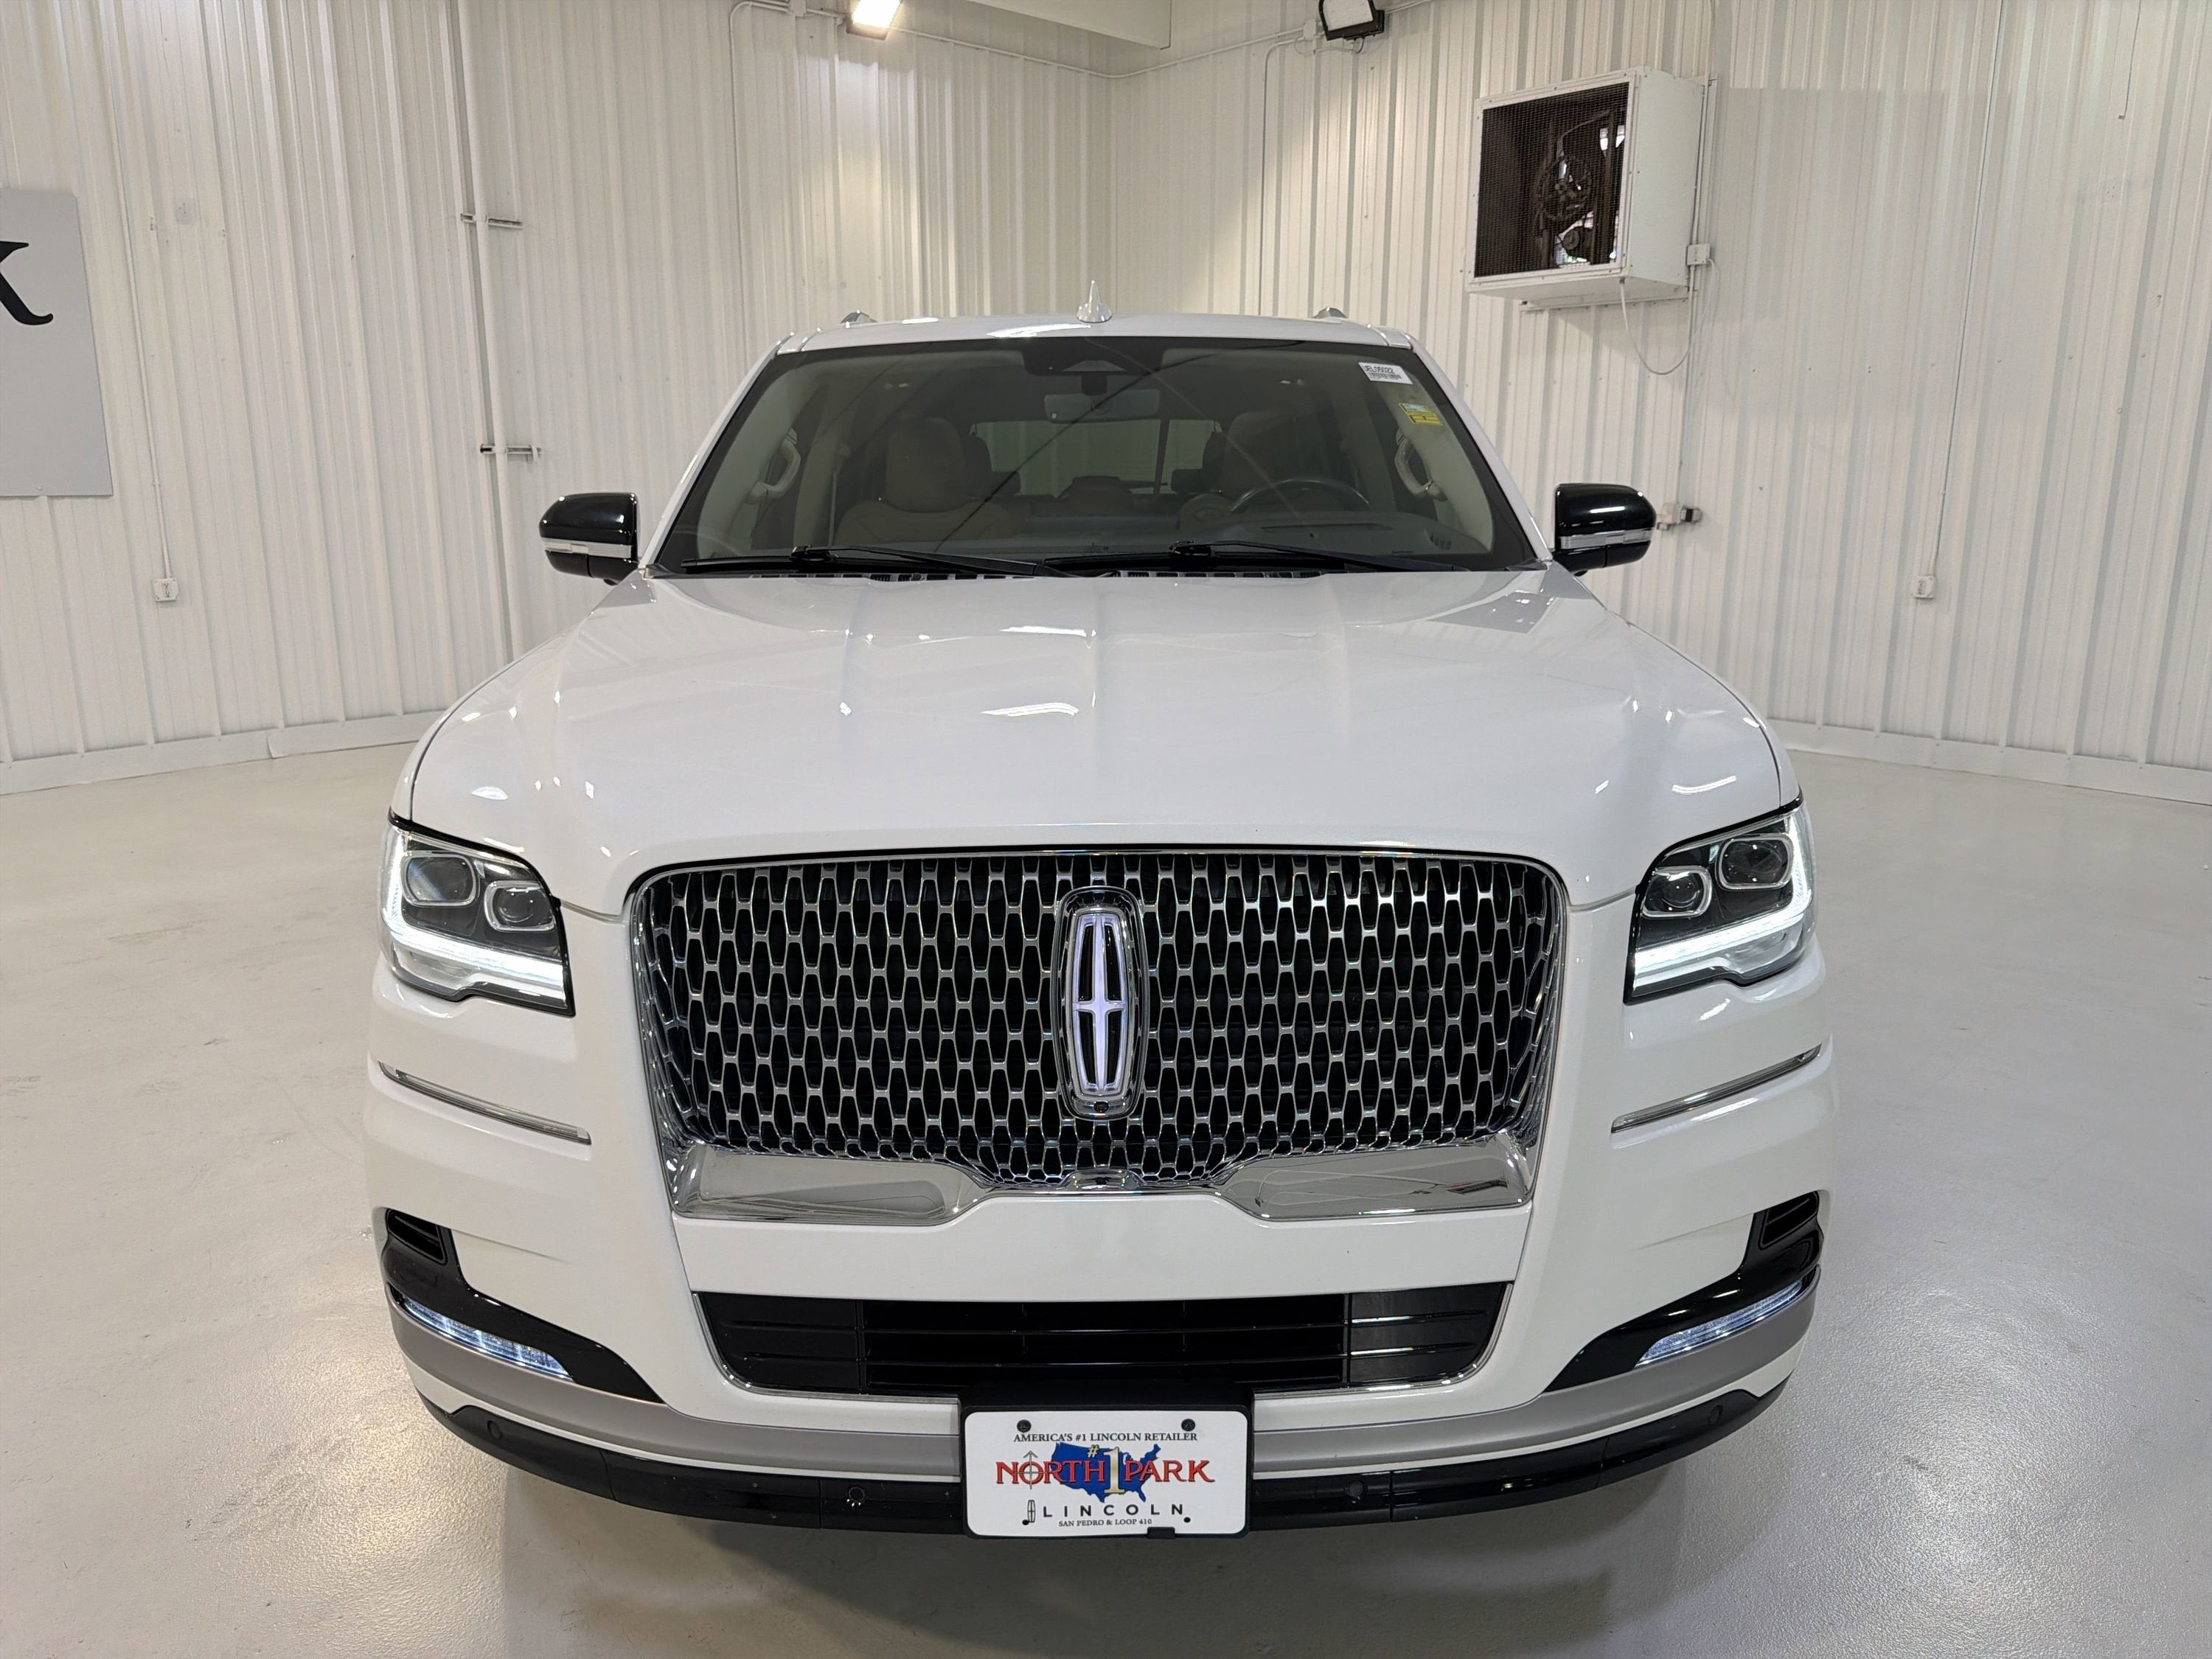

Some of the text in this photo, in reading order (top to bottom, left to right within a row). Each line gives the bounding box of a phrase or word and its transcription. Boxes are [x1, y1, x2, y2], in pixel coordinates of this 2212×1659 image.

[1013, 1433, 1074, 1442] AMERICA'S
[1090, 1433, 1141, 1441] LINCOLN
[1144, 1433, 1198, 1441] RETAILER
[996, 1459, 1215, 1484] NORTH PARK
[1043, 1503, 1183, 1517] LINCOLN
